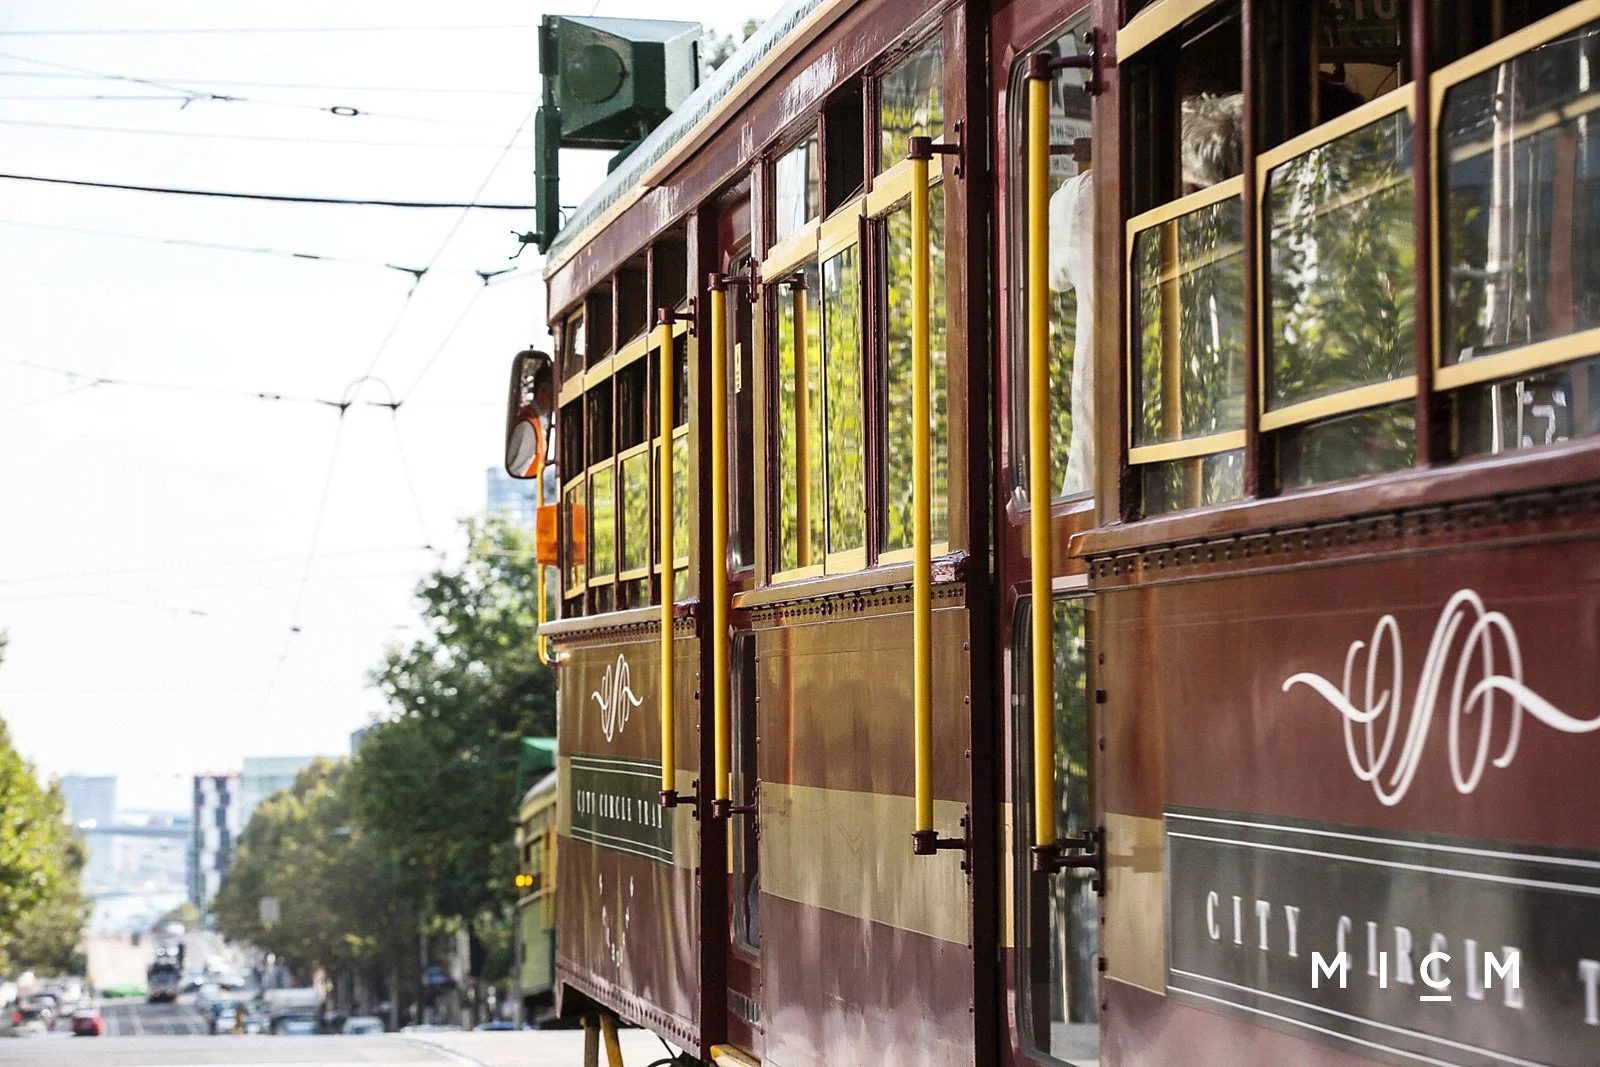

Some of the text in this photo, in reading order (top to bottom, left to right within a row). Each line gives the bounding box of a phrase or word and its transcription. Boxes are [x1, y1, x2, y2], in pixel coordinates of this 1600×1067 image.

[577, 790, 595, 815] CITY
[600, 793, 632, 822] CIRCLE
[1207, 890, 1300, 958] CITY
